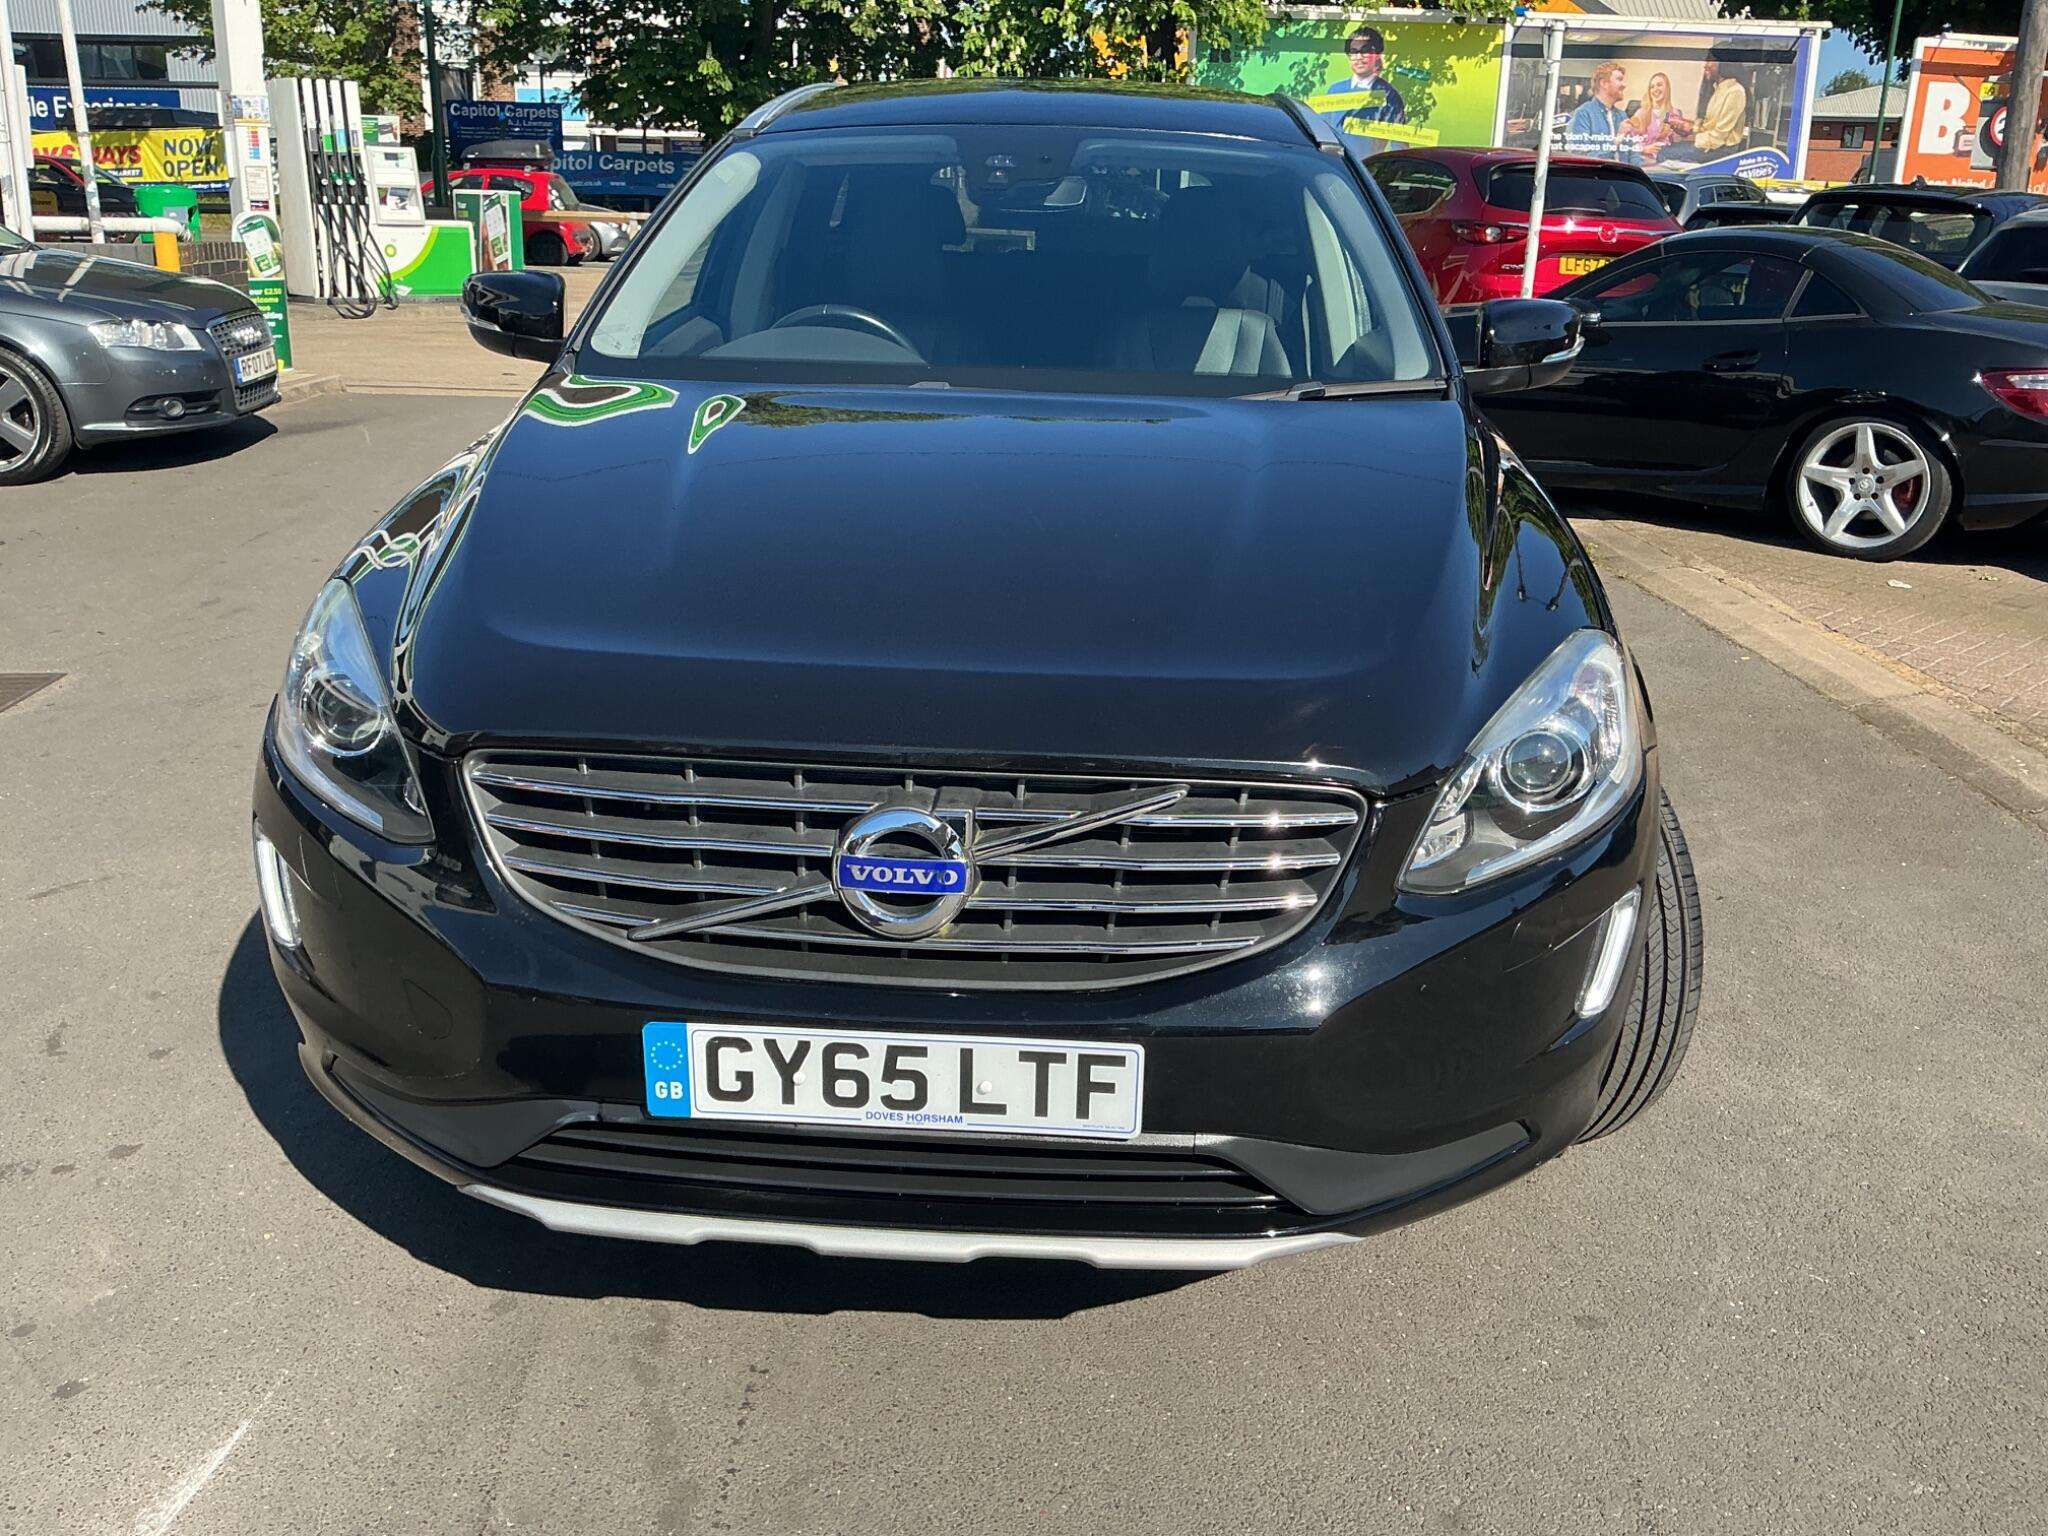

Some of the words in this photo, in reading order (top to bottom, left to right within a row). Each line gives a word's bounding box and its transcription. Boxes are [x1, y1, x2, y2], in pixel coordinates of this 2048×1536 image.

[450, 103, 500, 119] Capitol
[504, 105, 560, 120] Carpets
[1550, 132, 1562, 141] he
[163, 138, 213, 157] NOW
[1564, 144, 1600, 154] escapes
[1602, 143, 1618, 152] the
[162, 158, 219, 178] OPEN
[543, 153, 593, 172] pitol
[599, 154, 675, 175] Carpets
[251, 296, 279, 304] elcome
[846, 863, 958, 886] VOLVO
[705, 1036, 929, 1110] GY65
[959, 1047, 1127, 1120] LTF
[655, 1081, 683, 1100] GB
[865, 1110, 905, 1123] DOVES
[906, 1112, 964, 1125] HORSHAM
